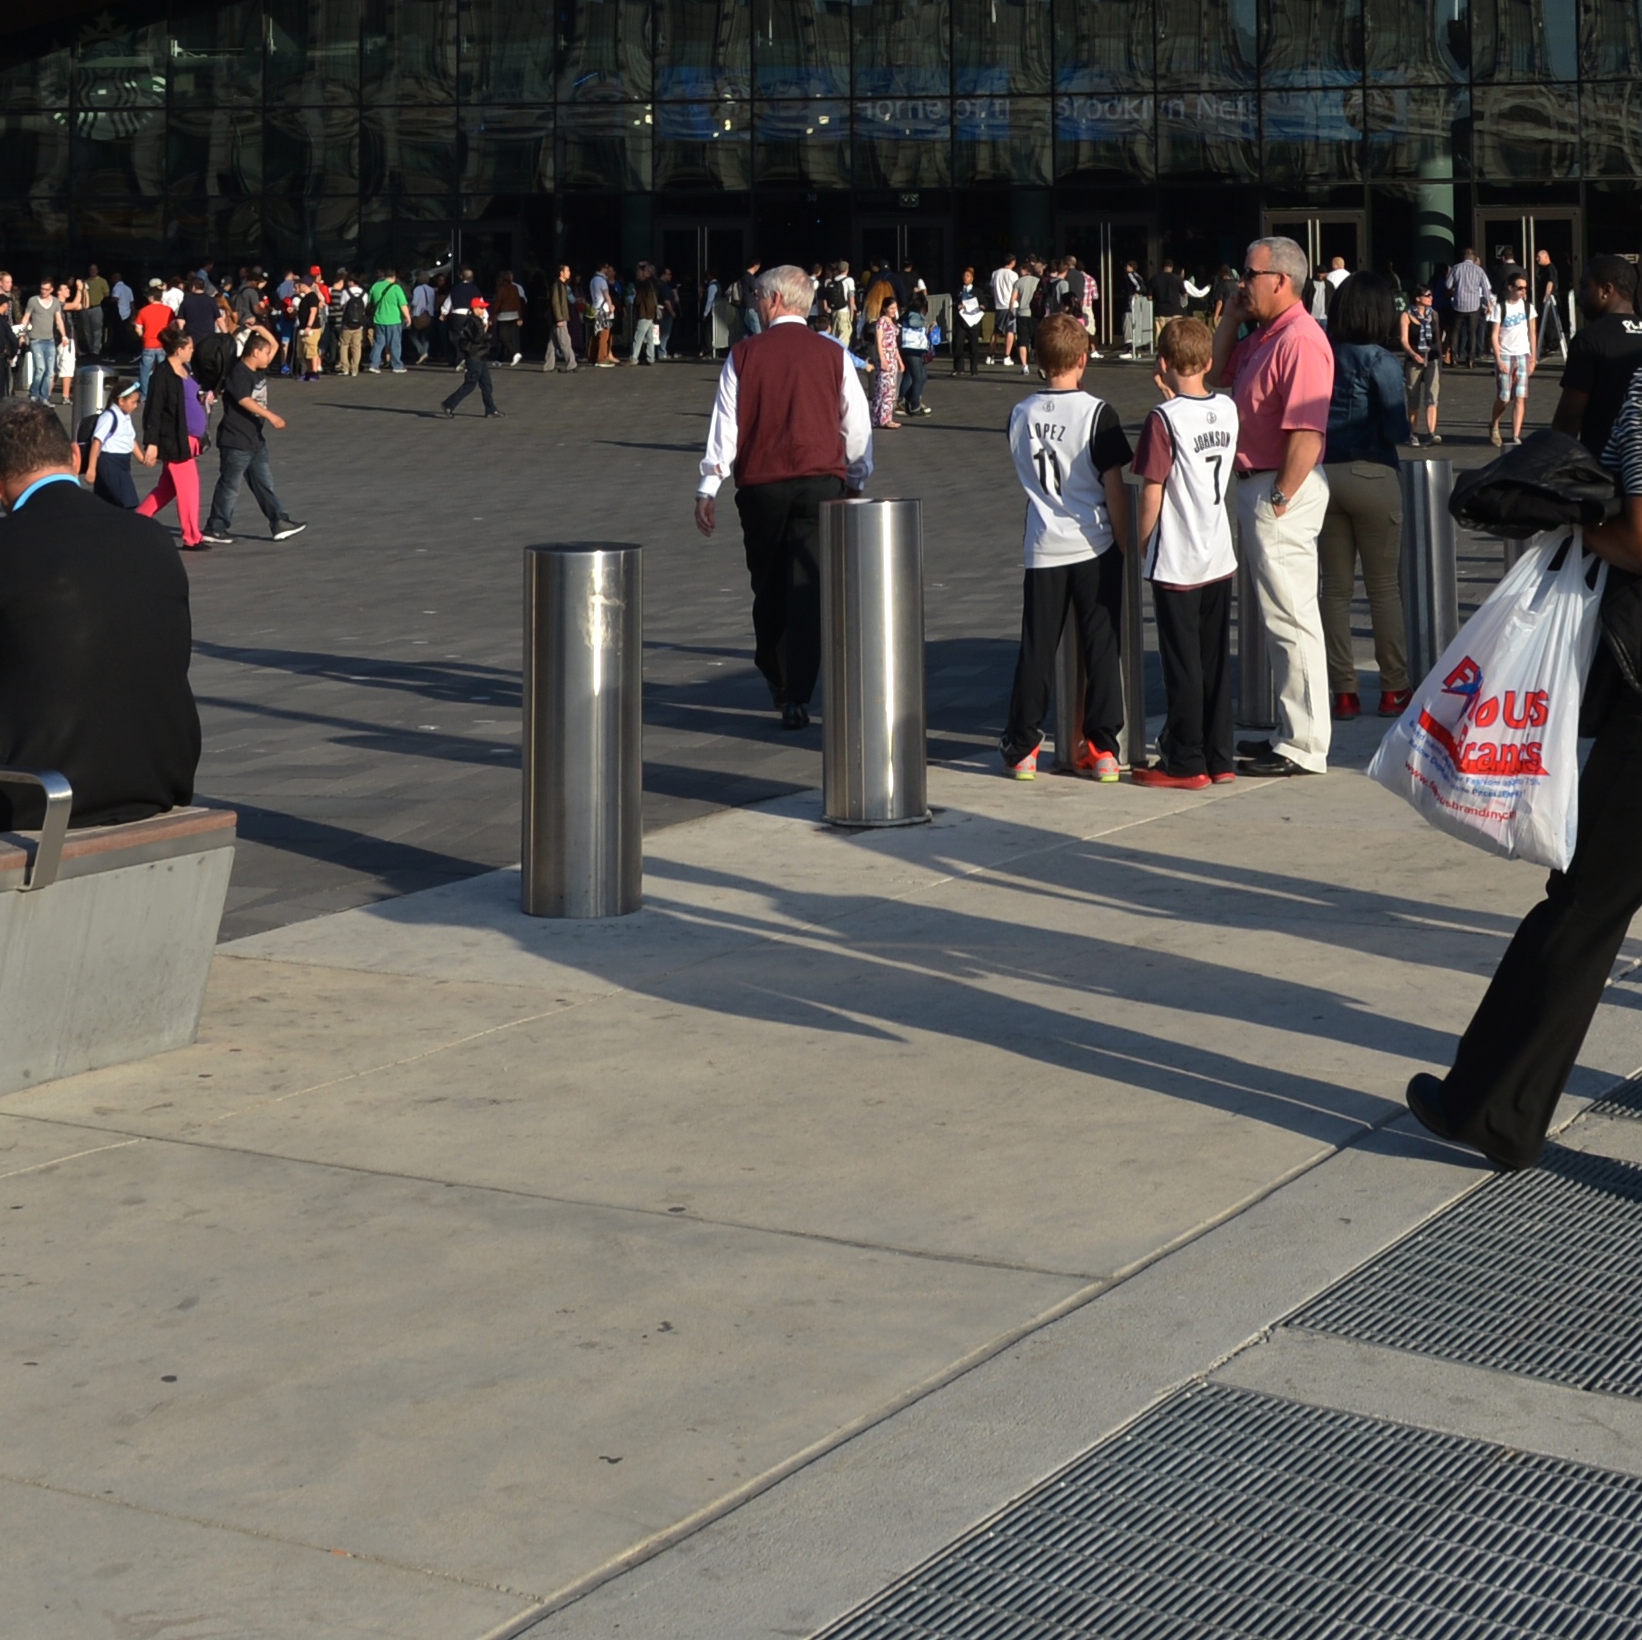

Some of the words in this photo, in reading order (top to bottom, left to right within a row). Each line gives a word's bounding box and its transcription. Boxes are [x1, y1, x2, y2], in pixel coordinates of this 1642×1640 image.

[1026, 422, 1067, 443] LOPEZ
[1193, 431, 1231, 454] JOHNSON
[1033, 448, 1063, 497] 11
[1205, 454, 1223, 506] 7
